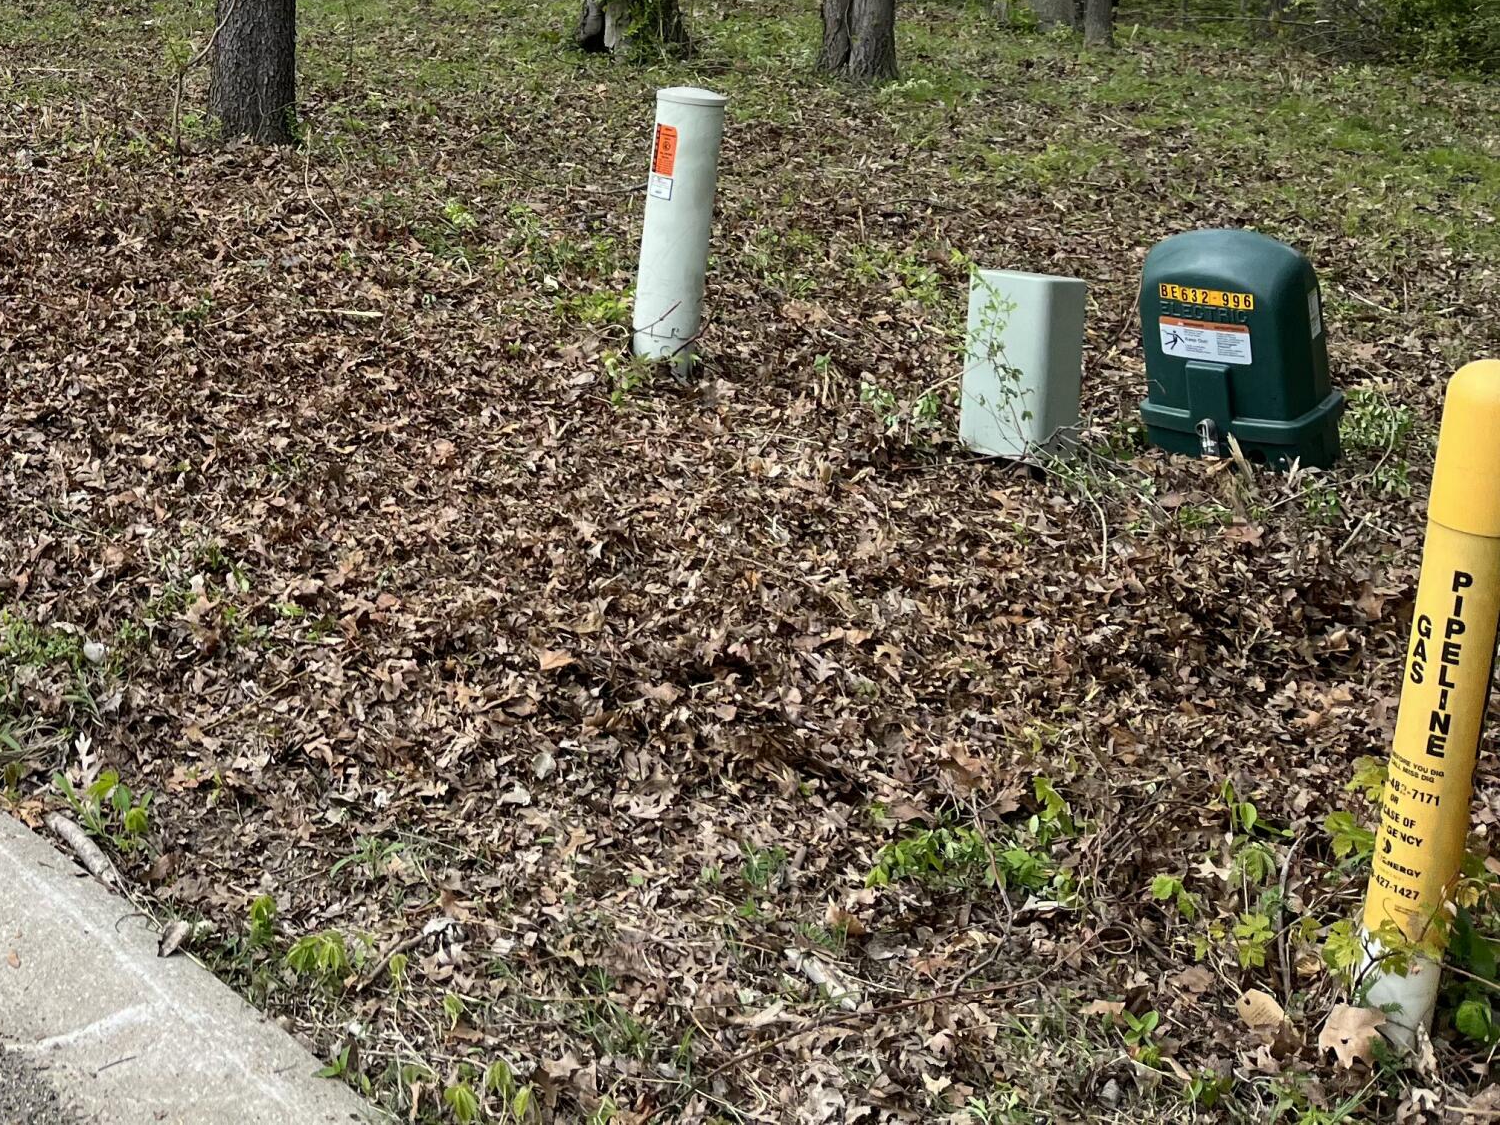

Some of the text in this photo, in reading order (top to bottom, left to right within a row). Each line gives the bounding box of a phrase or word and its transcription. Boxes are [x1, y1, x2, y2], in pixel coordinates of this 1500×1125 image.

[1160, 301, 1247, 323] ELECTRIC
[1410, 614, 1432, 684] GAS
[1425, 570, 1473, 758] PIPELINE
[1413, 763, 1429, 774] YOU
[1430, 769, 1445, 777] DIG
[1421, 774, 1435, 783] DIG
[1402, 817, 1417, 829] OF
